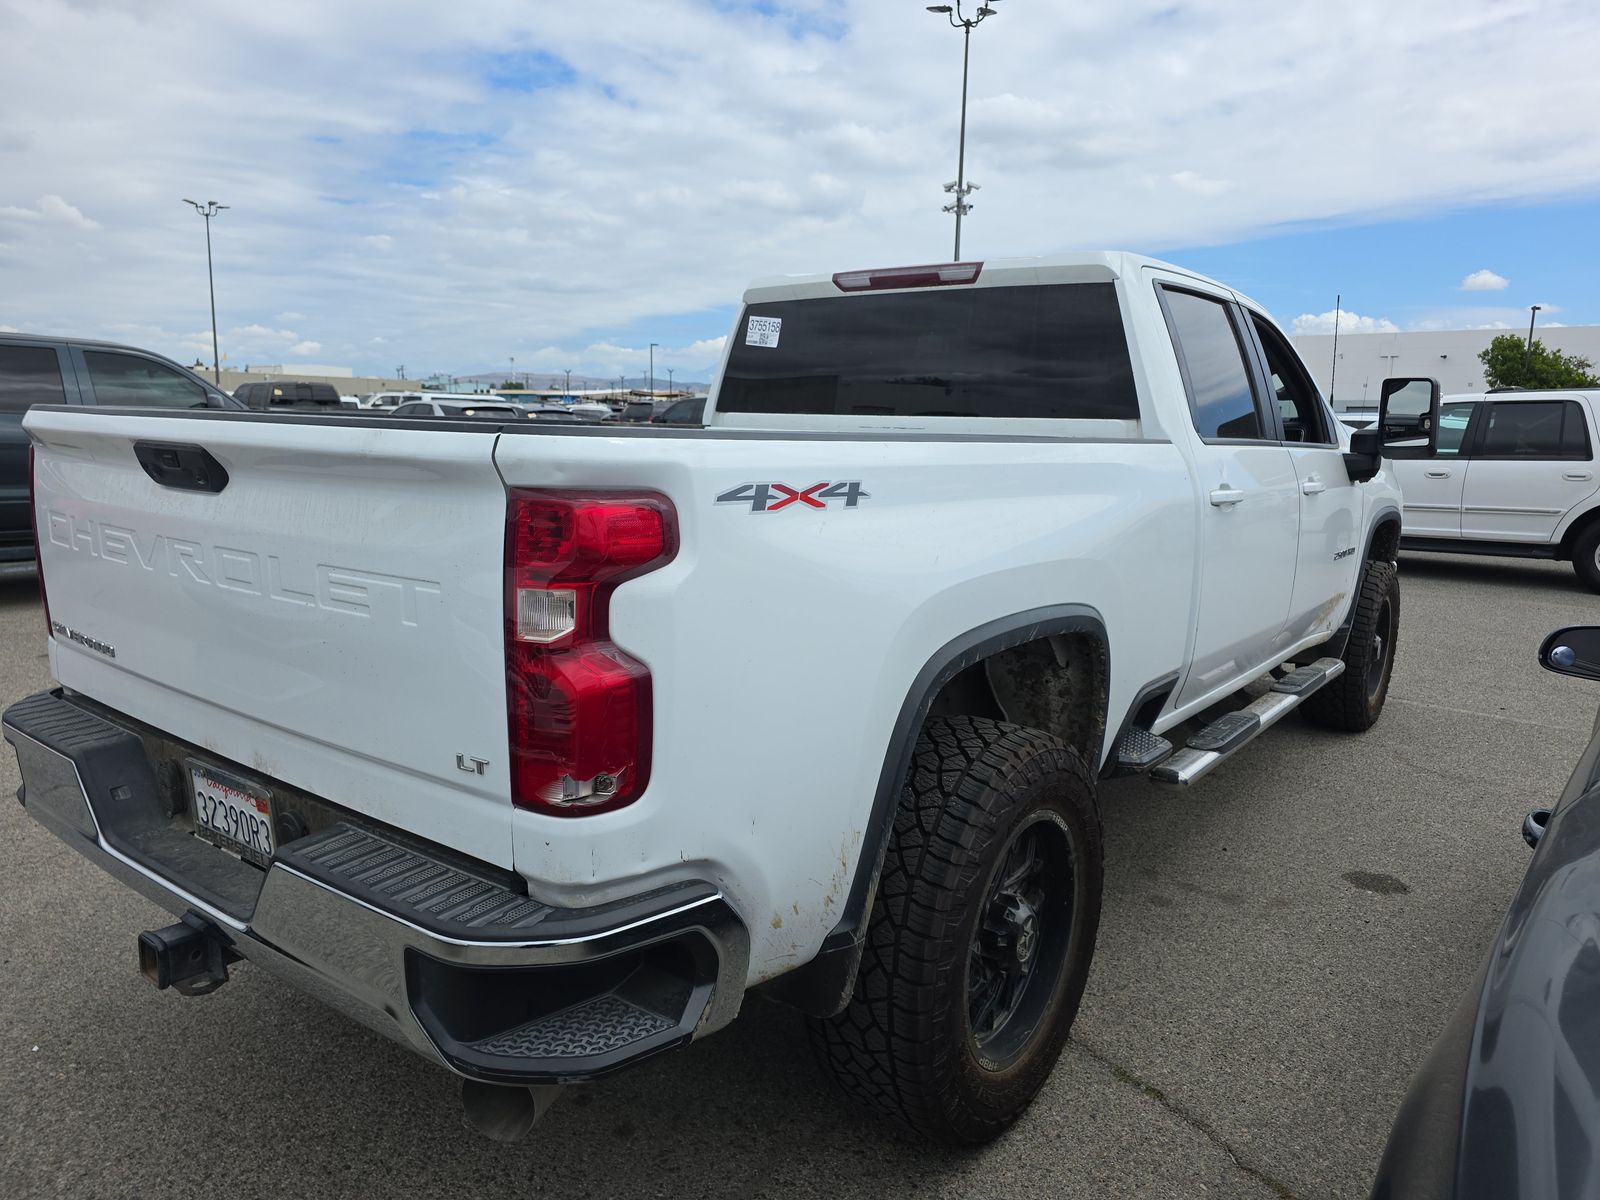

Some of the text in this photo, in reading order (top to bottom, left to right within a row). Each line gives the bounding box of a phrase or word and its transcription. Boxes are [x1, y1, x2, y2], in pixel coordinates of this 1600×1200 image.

[749, 319, 781, 333] 3755158
[48, 509, 441, 627] CHEVROLET
[456, 752, 489, 776] LT
[197, 790, 272, 856] 32390R3
